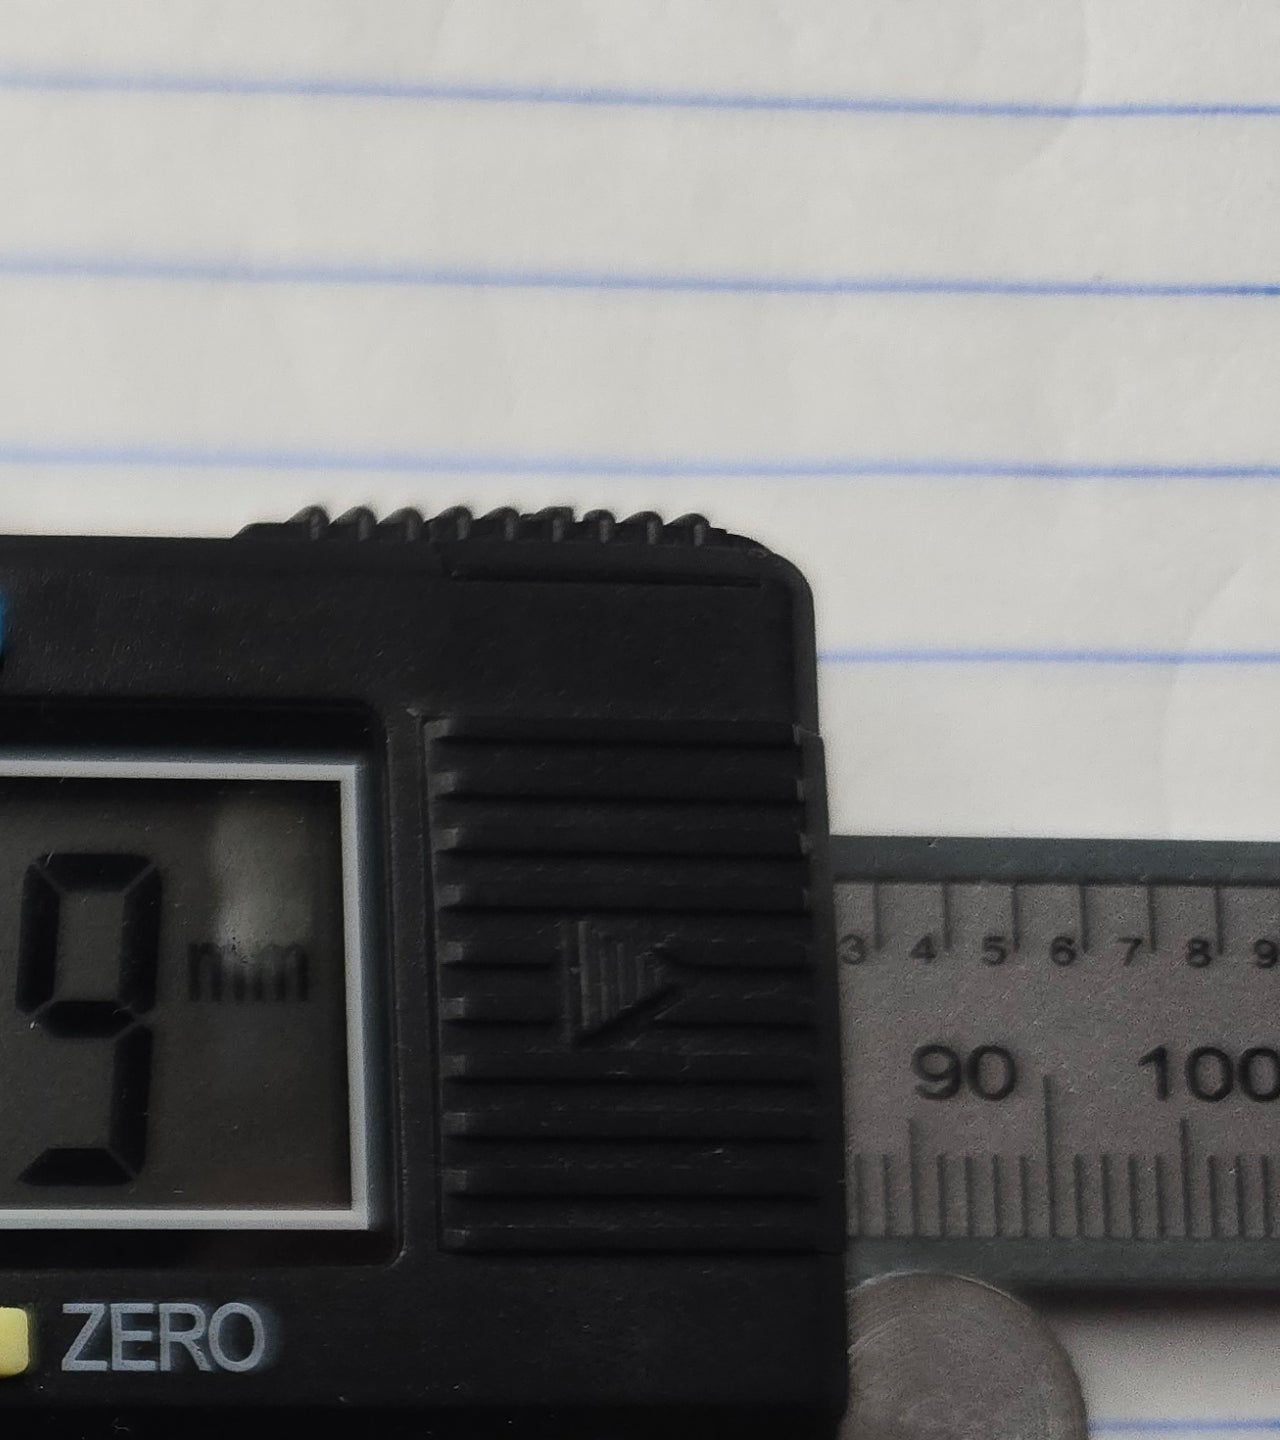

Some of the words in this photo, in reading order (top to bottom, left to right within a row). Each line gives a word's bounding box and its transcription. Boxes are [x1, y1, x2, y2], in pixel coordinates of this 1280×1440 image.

[840, 933, 867, 966] 3
[909, 934, 938, 963] 4
[981, 935, 1007, 966] 5
[1049, 936, 1077, 966] 6
[1117, 937, 1141, 966] 7
[1185, 938, 1213, 968] 8
[1252, 938, 1280, 969] 9
[911, 1043, 1017, 1101] 90
[1140, 1045, 1280, 1102] 100
[60, 1302, 266, 1372] ZERO
